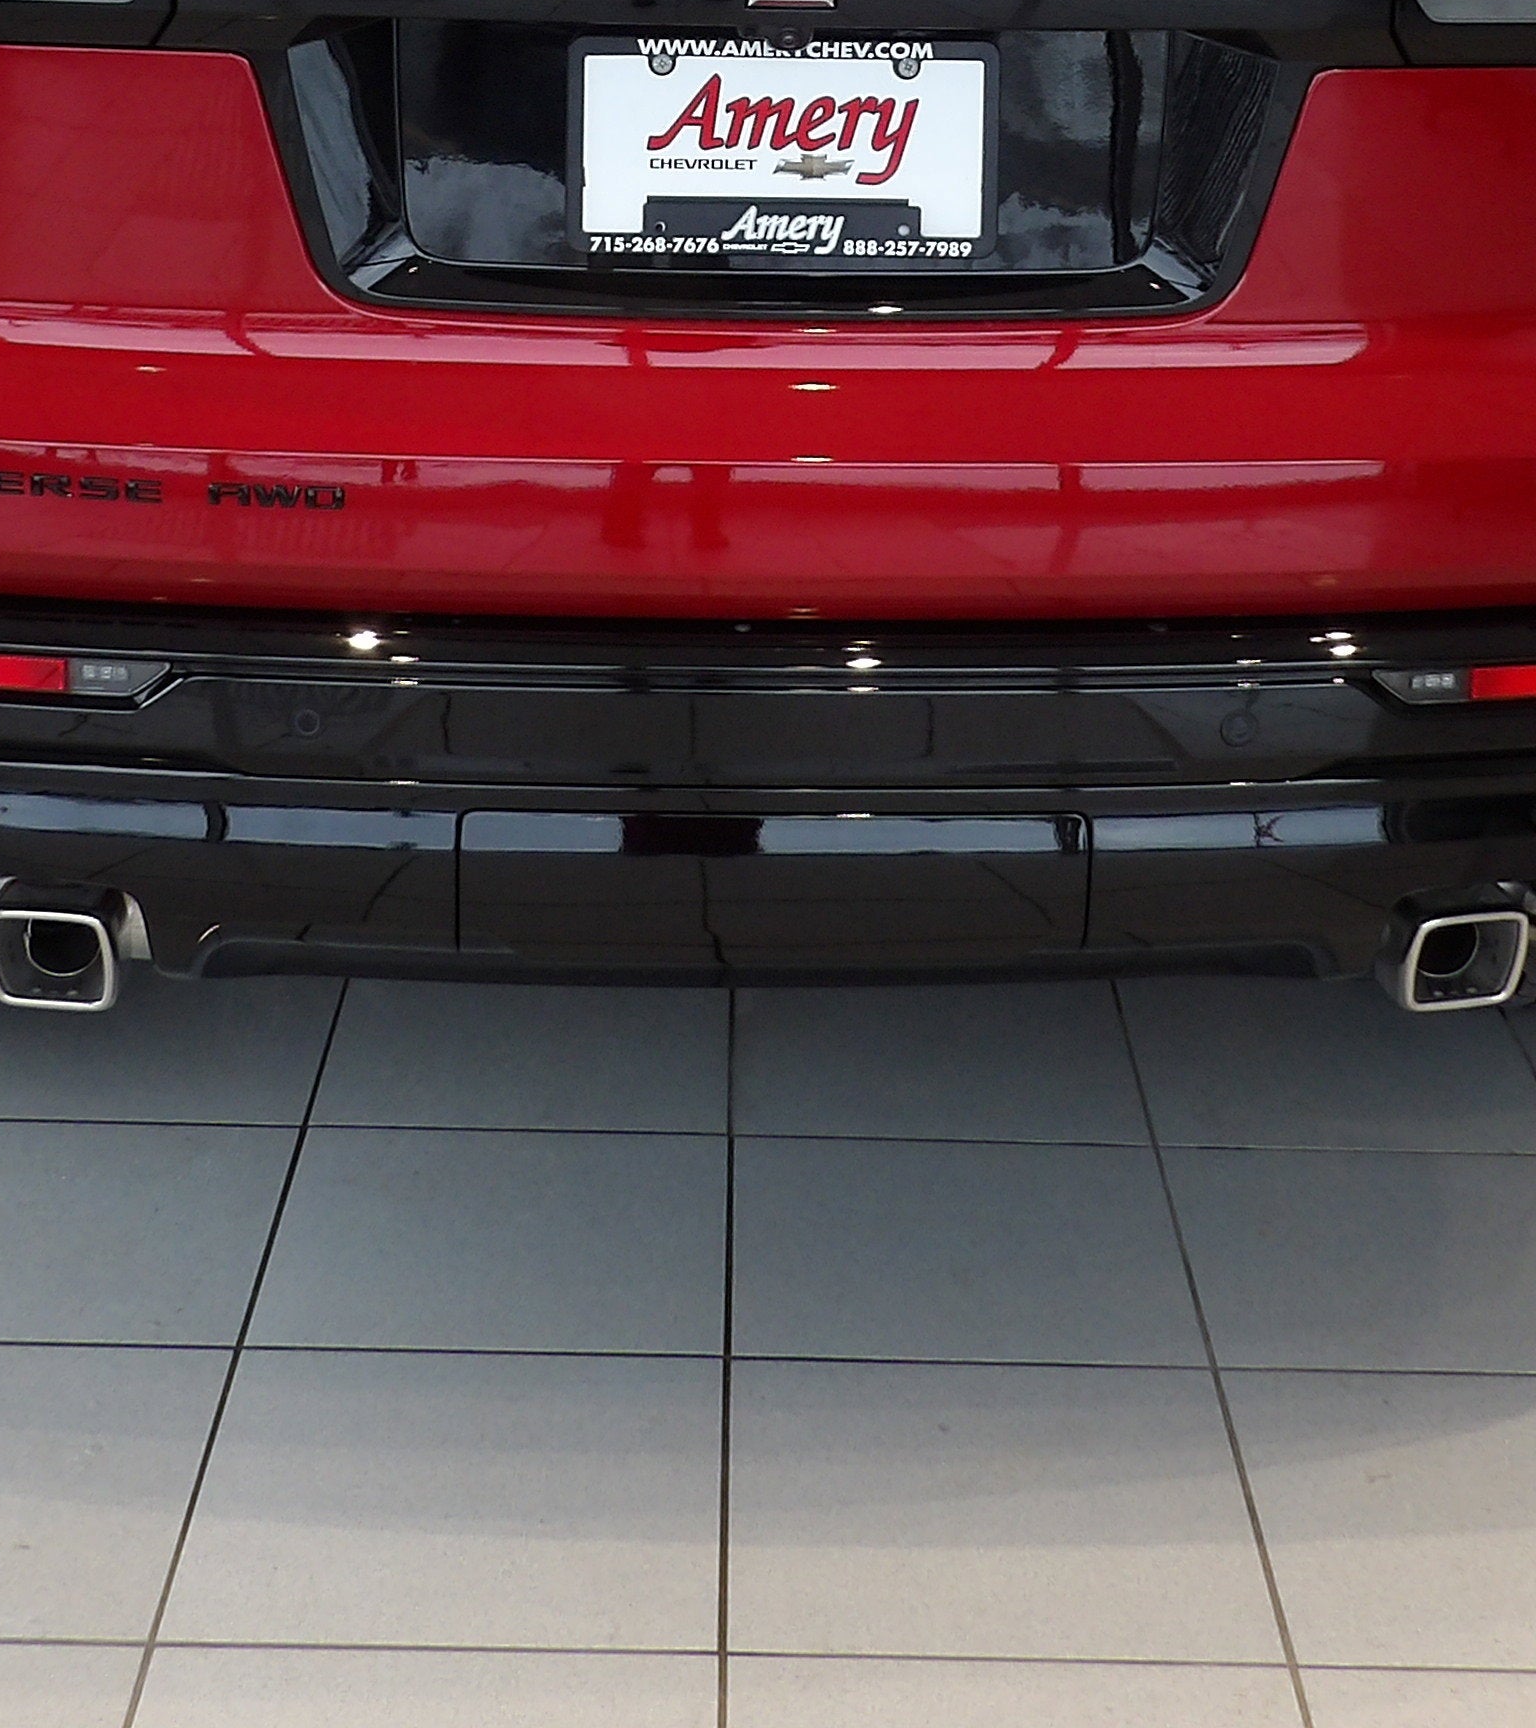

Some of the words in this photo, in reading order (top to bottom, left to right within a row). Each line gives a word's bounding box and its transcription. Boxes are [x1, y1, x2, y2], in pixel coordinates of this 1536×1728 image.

[646, 73, 920, 186] Amery
[649, 158, 758, 171] CHEVROLET
[720, 205, 845, 255] Amery
[590, 236, 720, 254] 715-268-7676
[843, 239, 973, 258] 888-257-7989
[207, 482, 345, 510] AWD
